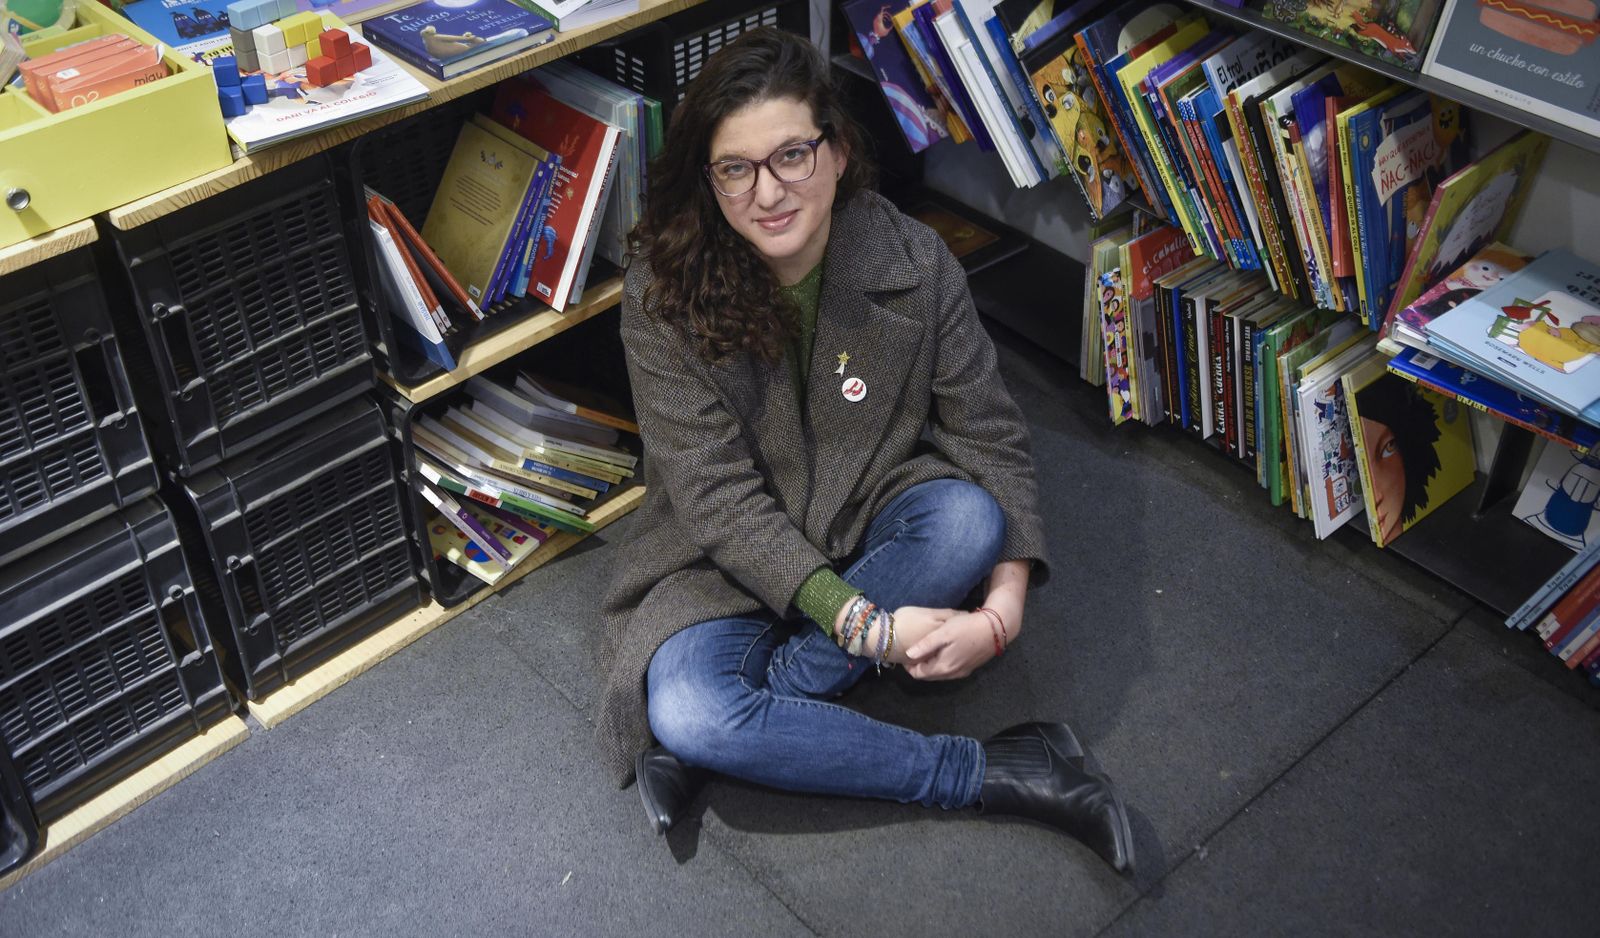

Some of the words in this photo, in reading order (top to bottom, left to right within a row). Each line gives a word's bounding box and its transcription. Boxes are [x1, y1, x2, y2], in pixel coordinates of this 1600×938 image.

[384, 14, 413, 24] Te
[401, 12, 450, 31] quiero
[1217, 64, 1229, 85] El
[1227, 55, 1244, 79] trol
[1469, 43, 1485, 54] un
[1487, 48, 1526, 68] chucho
[1528, 63, 1550, 77] con
[1551, 72, 1585, 88] estilo
[1351, 225, 1356, 235] AL
[1215, 355, 1224, 395] GUERRA
[1523, 361, 1545, 374] WELLS
